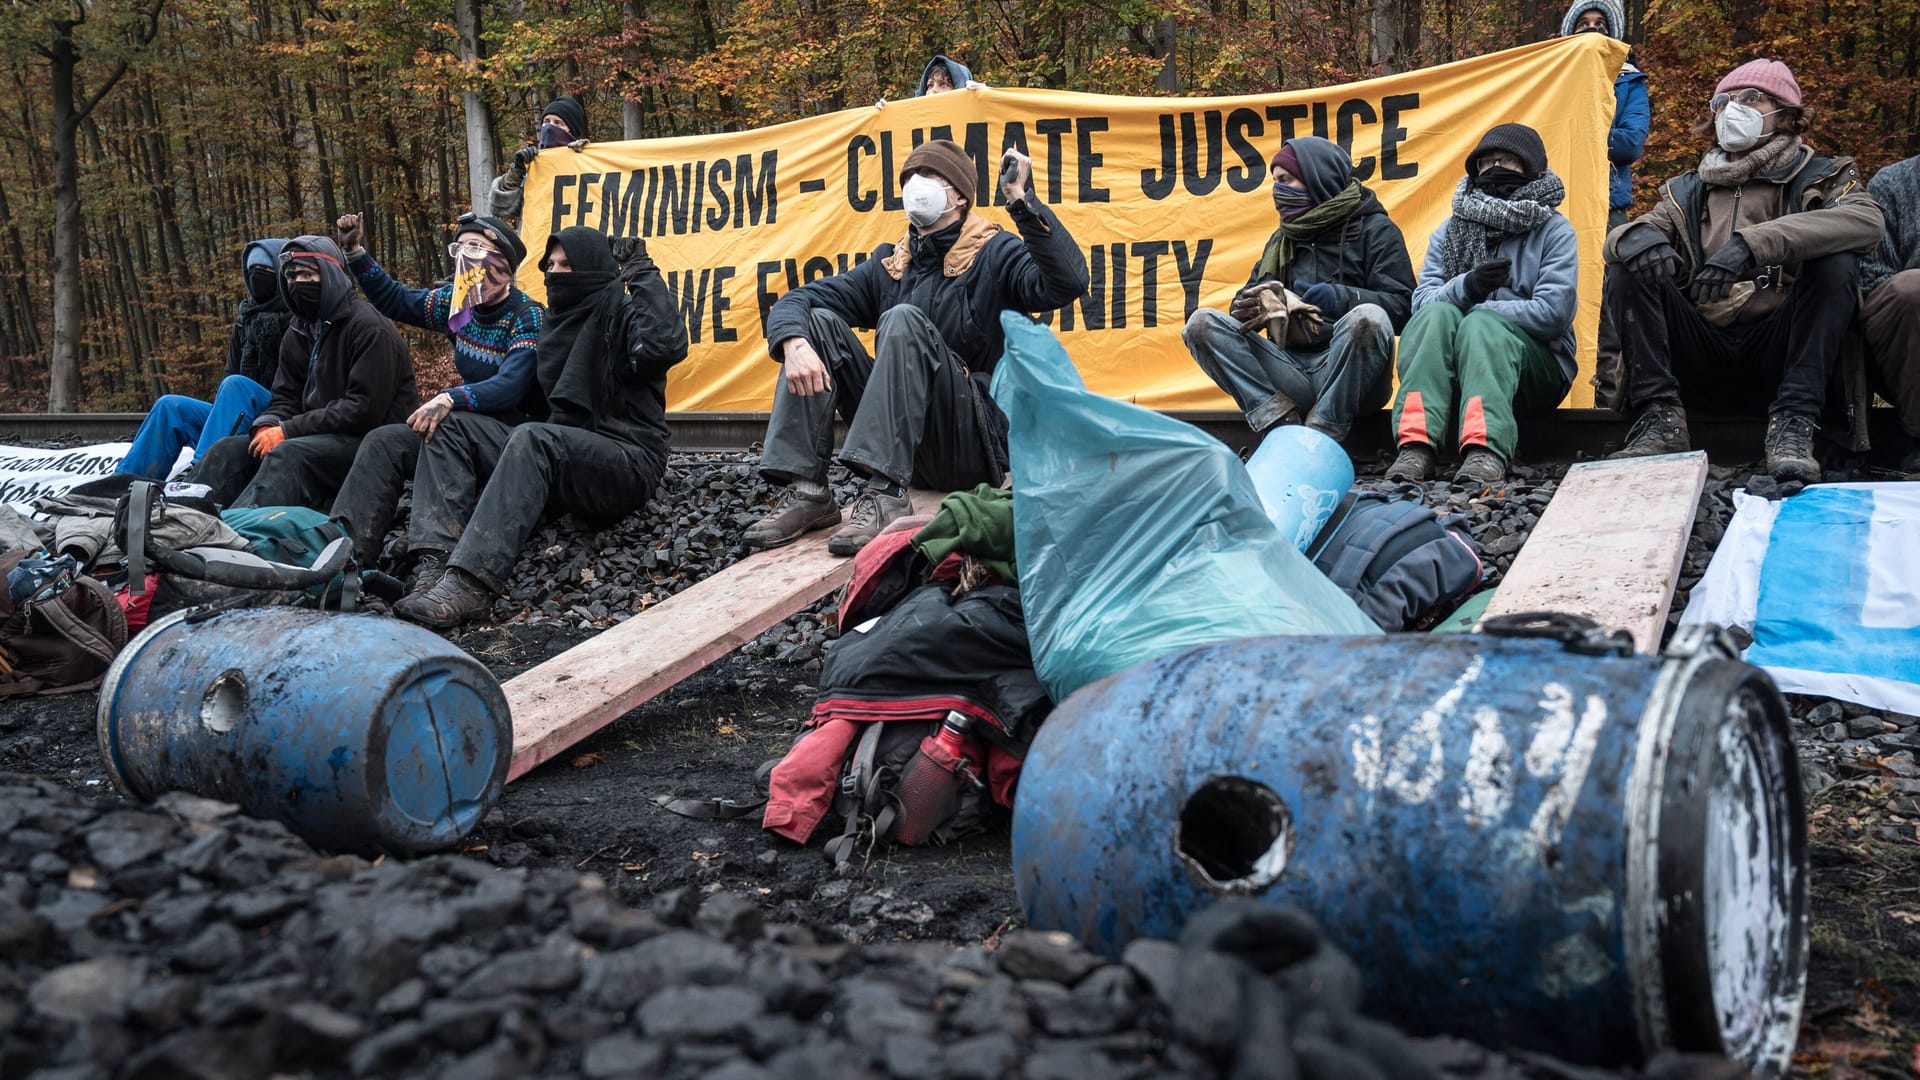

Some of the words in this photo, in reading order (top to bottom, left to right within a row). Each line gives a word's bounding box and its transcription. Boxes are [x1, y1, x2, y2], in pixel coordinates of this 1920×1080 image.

[551, 149, 778, 239] FEMINISM
[847, 117, 1110, 212] CLMATE
[668, 266, 738, 345] WE
[1029, 238, 1214, 333] NITY
